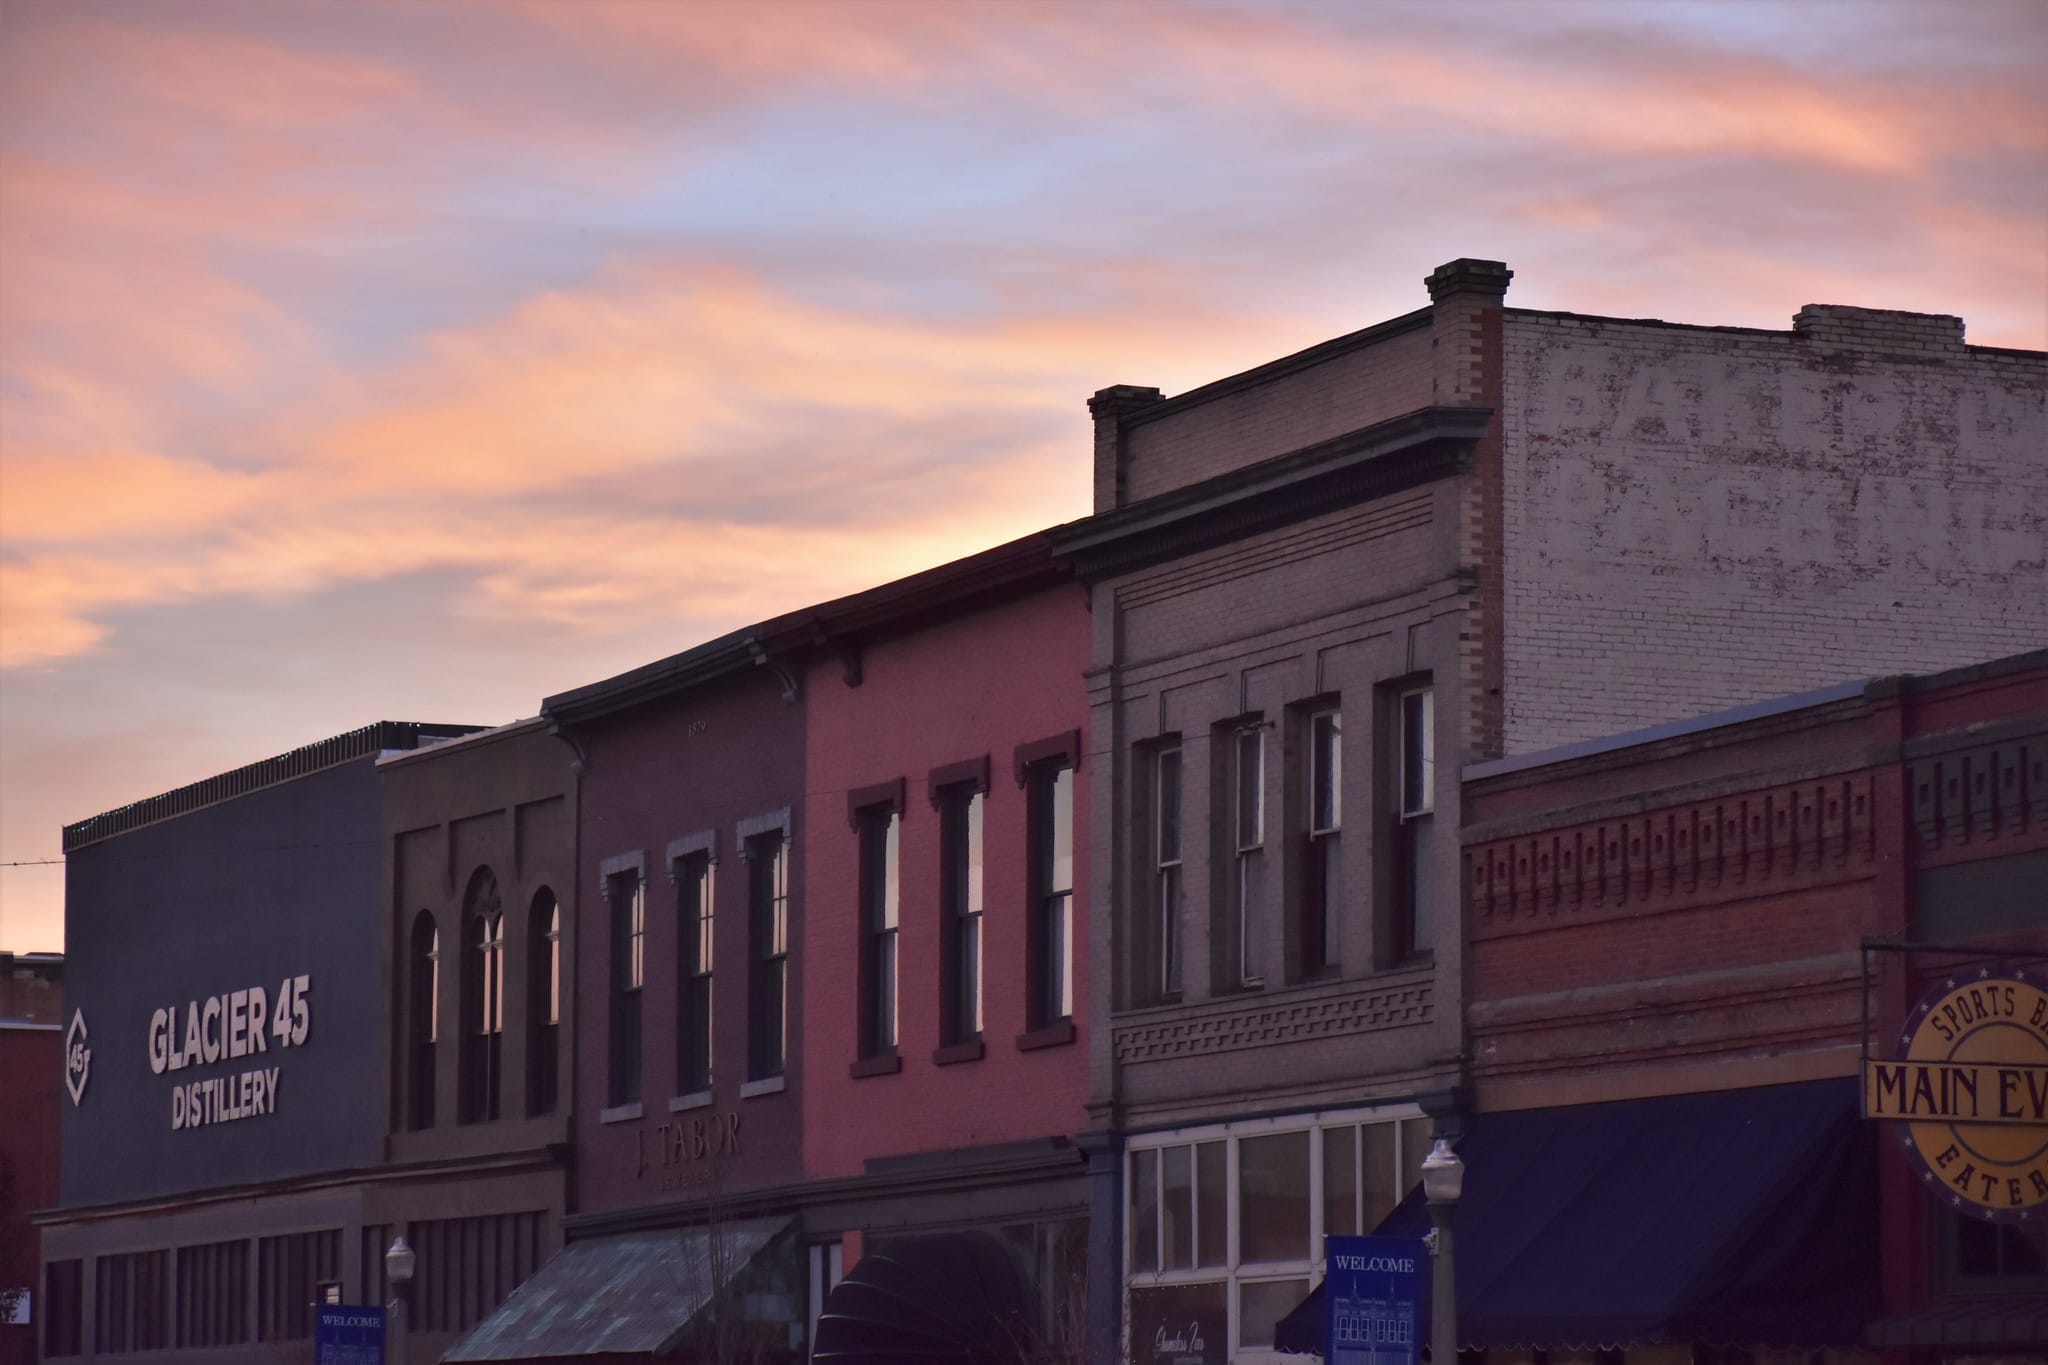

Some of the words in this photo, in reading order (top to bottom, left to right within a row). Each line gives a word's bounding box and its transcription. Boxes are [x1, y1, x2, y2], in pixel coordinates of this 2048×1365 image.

[149, 986, 268, 1075] GLACIER
[272, 974, 311, 1048] 45
[1931, 985, 2016, 1041] SPORTS
[171, 1066, 280, 1130] DISTILLERY
[1875, 1065, 1978, 1117] MAIN
[657, 1112, 741, 1166] TABOR
[1335, 1255, 1416, 1273] WELCOME
[321, 1315, 381, 1328] WELCOME
